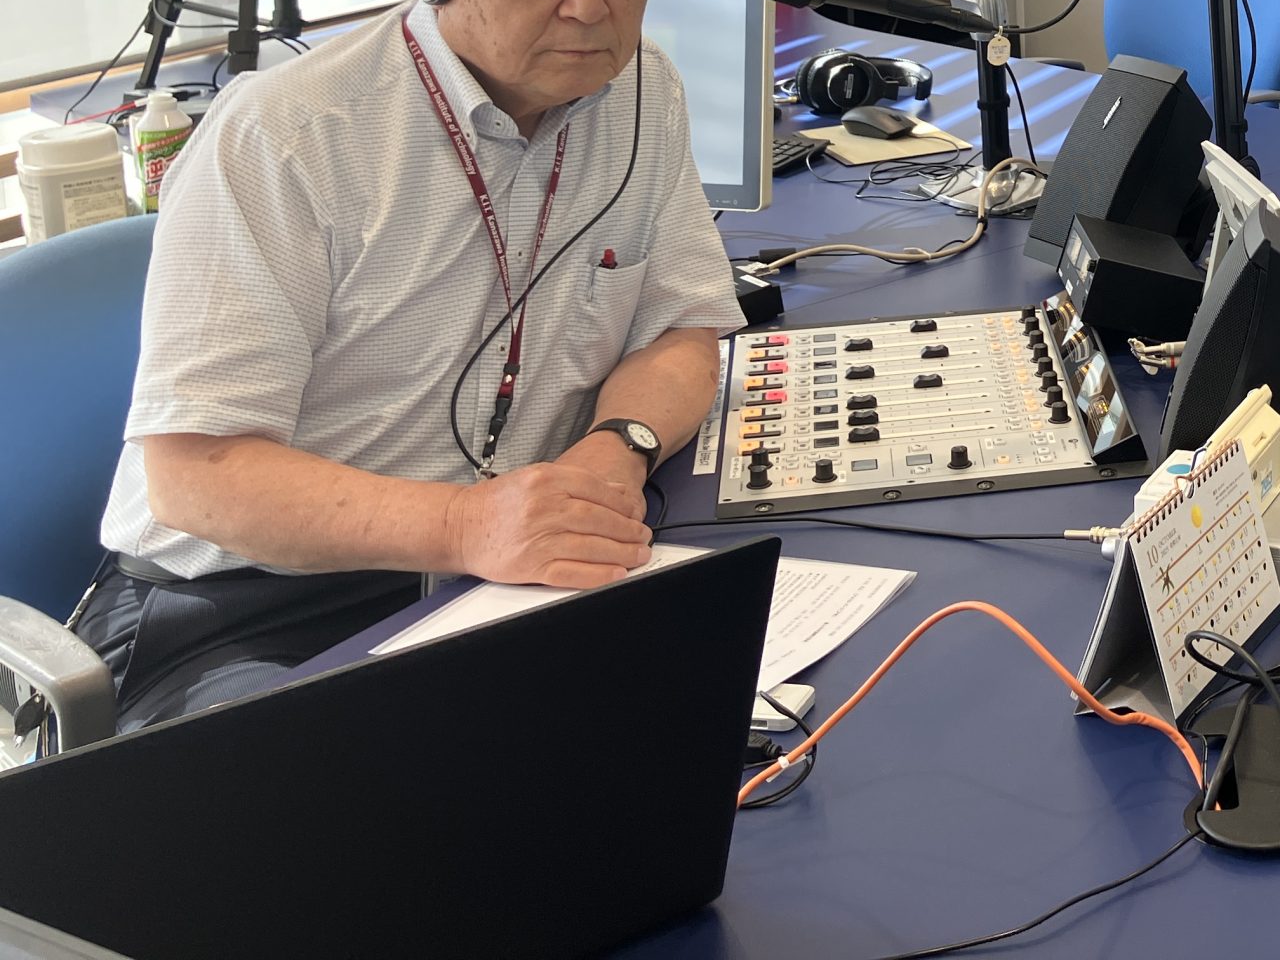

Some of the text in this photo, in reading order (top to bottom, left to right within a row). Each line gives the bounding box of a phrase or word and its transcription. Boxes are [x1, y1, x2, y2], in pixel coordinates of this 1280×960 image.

[416, 58, 437, 92] Kanazawa
[434, 92, 452, 124] Institute
[449, 124, 459, 132] of
[453, 131, 477, 175] Technology
[487, 214, 503, 254] Kanazawa
[1145, 542, 1159, 568] 10
